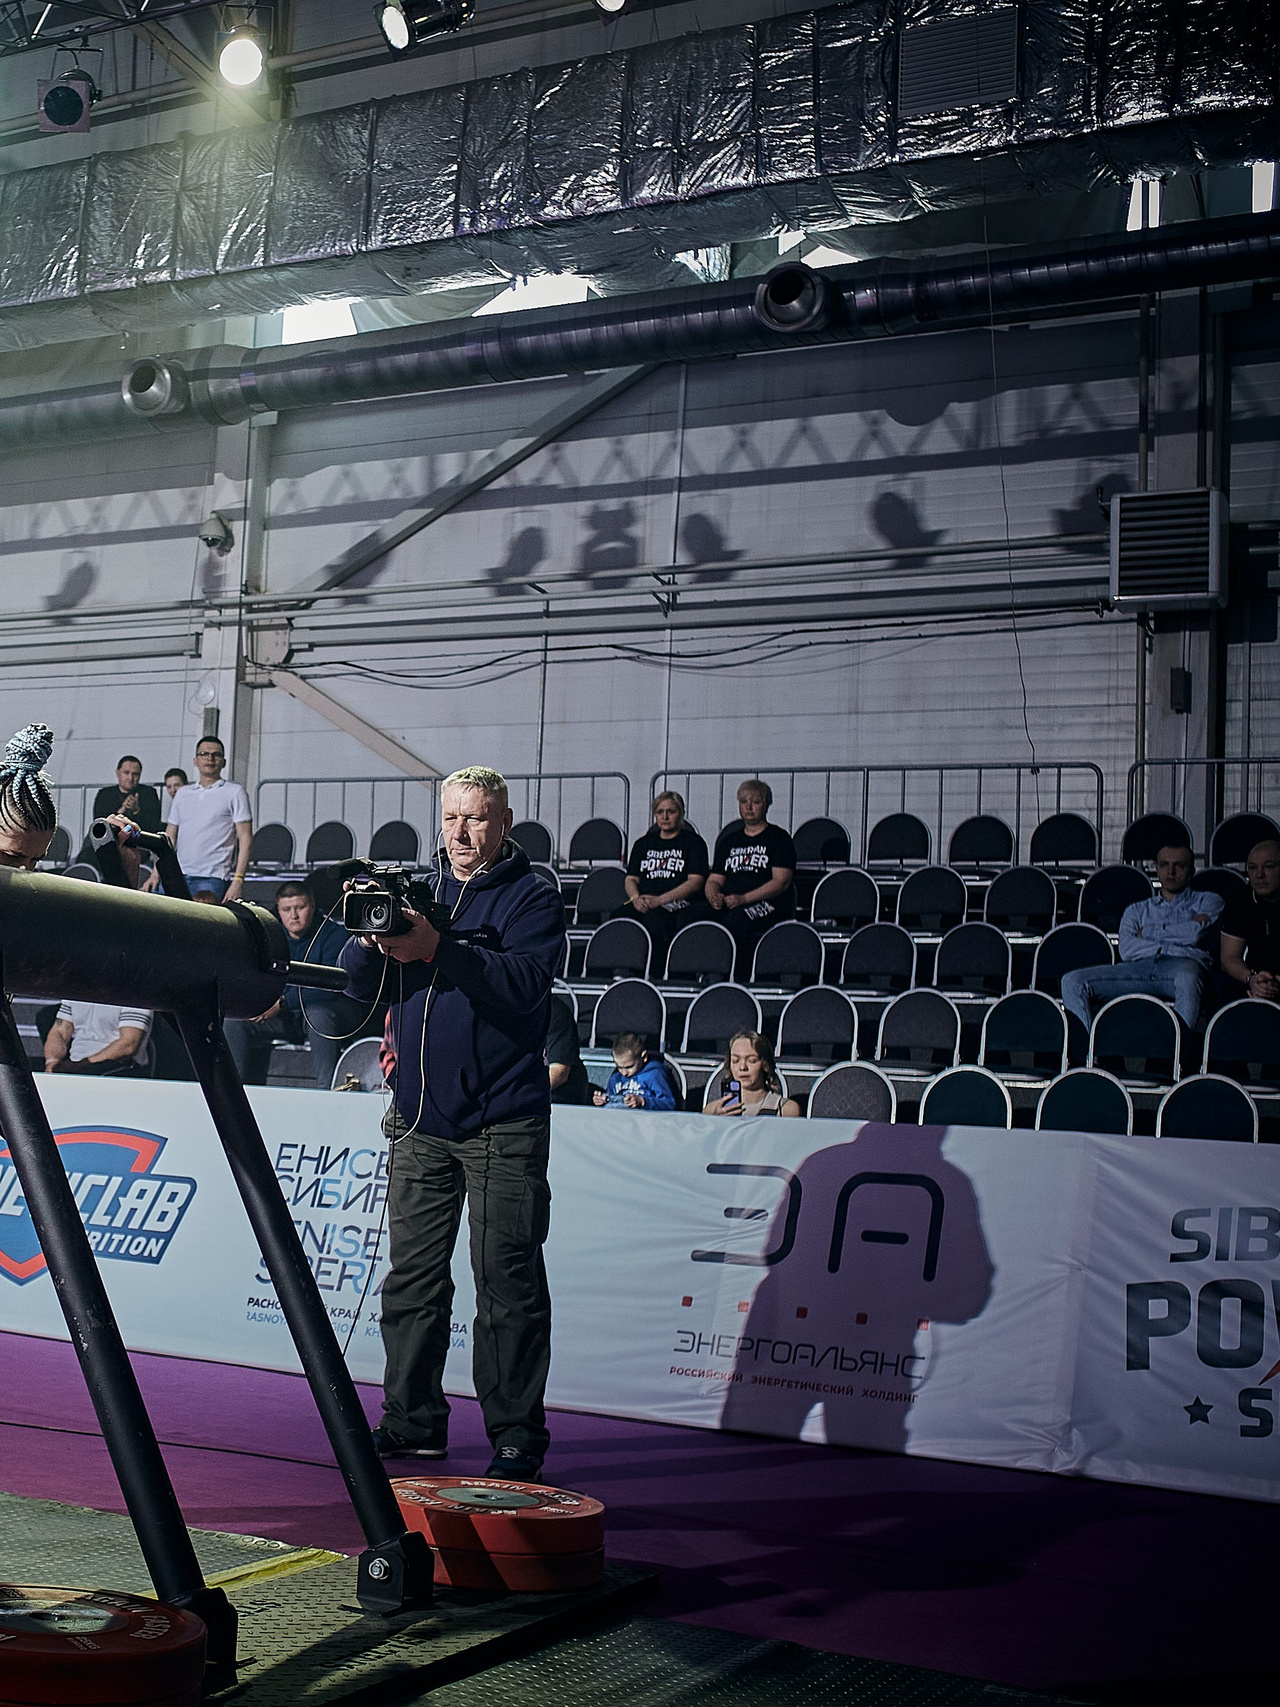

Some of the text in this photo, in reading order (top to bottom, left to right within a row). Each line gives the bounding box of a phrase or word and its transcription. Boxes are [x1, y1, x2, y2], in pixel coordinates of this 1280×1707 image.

[640, 859, 685, 873] POWER
[724, 854, 769, 872] POWER
[86, 1229, 166, 1258] RITION
[293, 1220, 387, 1262] NISE
[1126, 1279, 1280, 1371] PO
[673, 1330, 926, 1380] ЭНЕРГОАЛЬЯНС
[669, 1366, 919, 1404] РОССИЙСКИЙ ЭНЕРГЕТИЧЕСКИЙ ХОЛДИНГ
[76, 1591, 172, 1641] AGAIN FASTER
